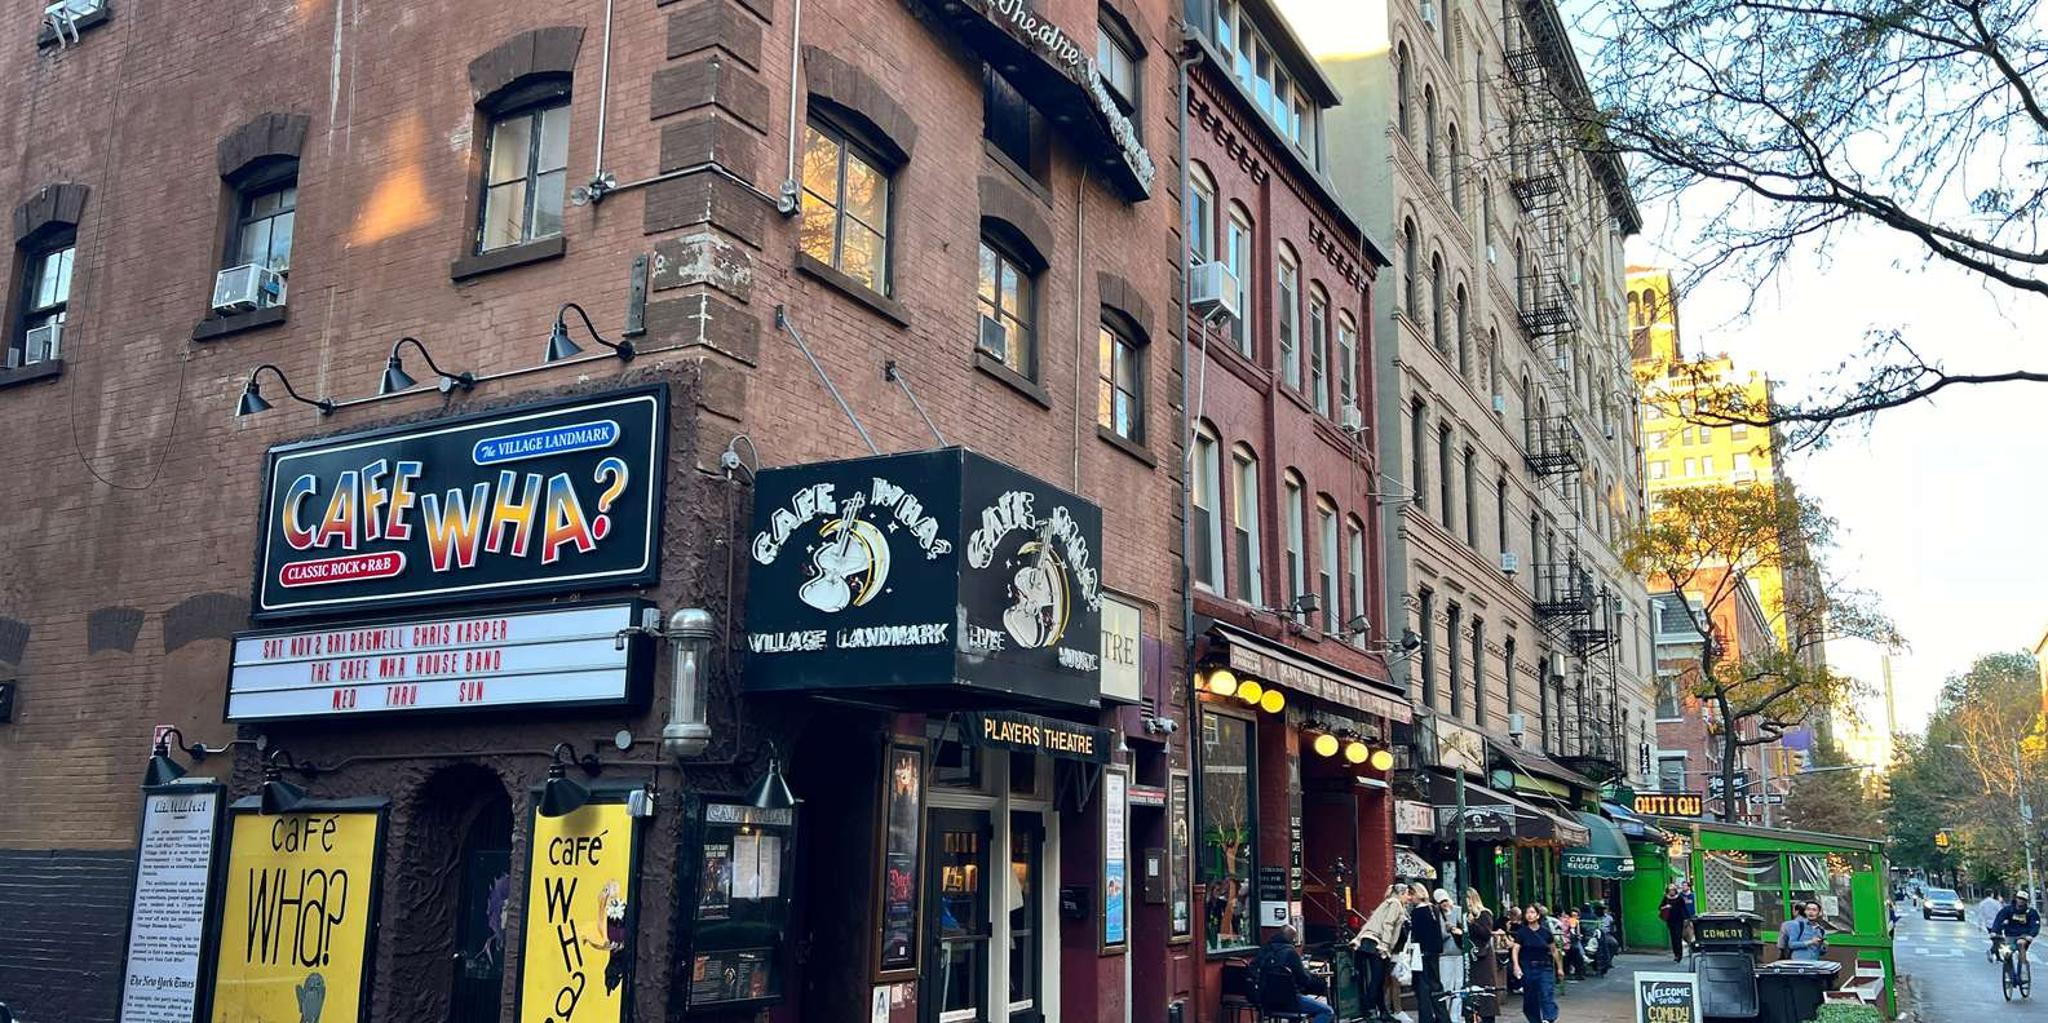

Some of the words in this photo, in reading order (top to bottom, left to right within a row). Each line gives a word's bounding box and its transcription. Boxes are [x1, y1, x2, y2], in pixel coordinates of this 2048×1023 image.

[481, 445, 496, 459] The
[498, 436, 544, 456] VILLAGE
[545, 426, 610, 449] LANDMARK
[282, 457, 424, 551] CAFE
[419, 456, 630, 573] WHA?
[752, 482, 837, 565] CAFE
[869, 476, 952, 561] WHA?
[287, 563, 329, 580] CLASSIC
[263, 639, 284, 659] SAT
[291, 637, 312, 657] NOV
[315, 635, 322, 655] 2
[349, 629, 403, 652] BAGWELL
[413, 624, 451, 647] CHRIS
[457, 619, 508, 643] KASPER
[748, 629, 829, 654] VILLAGE
[836, 622, 950, 649] LANDMARK
[311, 662, 331, 682] THE
[340, 659, 369, 680] CAFE
[416, 653, 457, 675] HOUSE
[466, 650, 501, 673] BAND
[333, 688, 356, 710] WED
[386, 684, 417, 706] THRU
[459, 681, 484, 703] SUN
[984, 718, 1040, 746] PLAYERS
[1043, 728, 1093, 754] THEATRE
[1647, 1006, 1690, 1022] COMEDY
